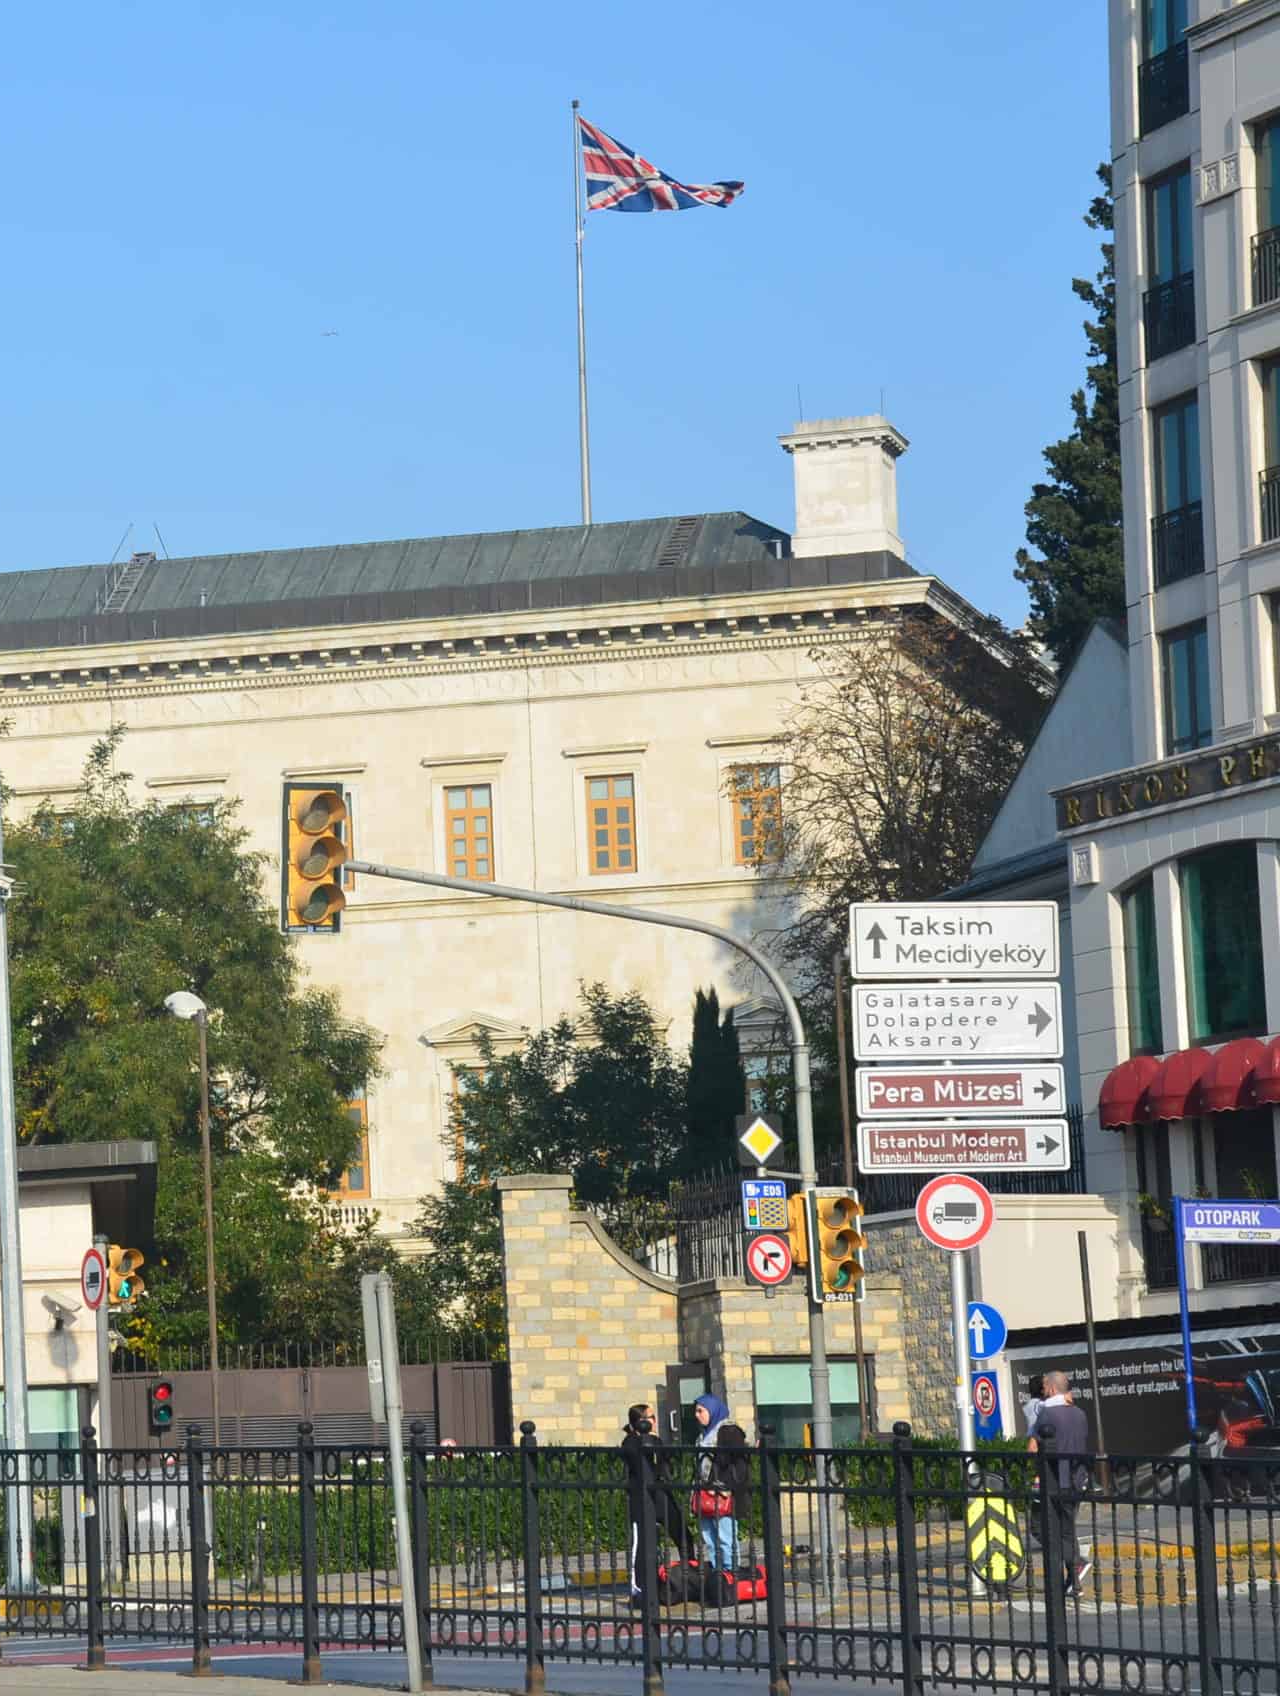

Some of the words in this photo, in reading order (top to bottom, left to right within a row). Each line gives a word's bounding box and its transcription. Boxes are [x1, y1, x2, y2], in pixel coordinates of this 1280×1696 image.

[1066, 764, 1190, 825] RIXOS
[896, 916, 992, 935] Taksim
[896, 943, 1046, 968] Mecidiyeköy
[865, 993, 1018, 1010] Galatasaray
[866, 1012, 997, 1030] Dolapdere
[868, 1032, 981, 1050] Aksaray
[869, 1081, 924, 1103] Pera
[934, 1079, 1022, 1102] Müzesi
[874, 1131, 945, 1149] İstanbul
[952, 1132, 1018, 1148] Modern
[914, 1151, 955, 1162] Museum
[957, 1151, 967, 1161] of
[969, 1150, 1005, 1162] Modern
[1007, 1149, 1023, 1161] Art
[763, 1185, 782, 1196] EDS
[1194, 1209, 1261, 1225] OTOPARK
[1121, 1363, 1142, 1376] faster
[1143, 1360, 1160, 1374] from
[1160, 1359, 1173, 1372] the
